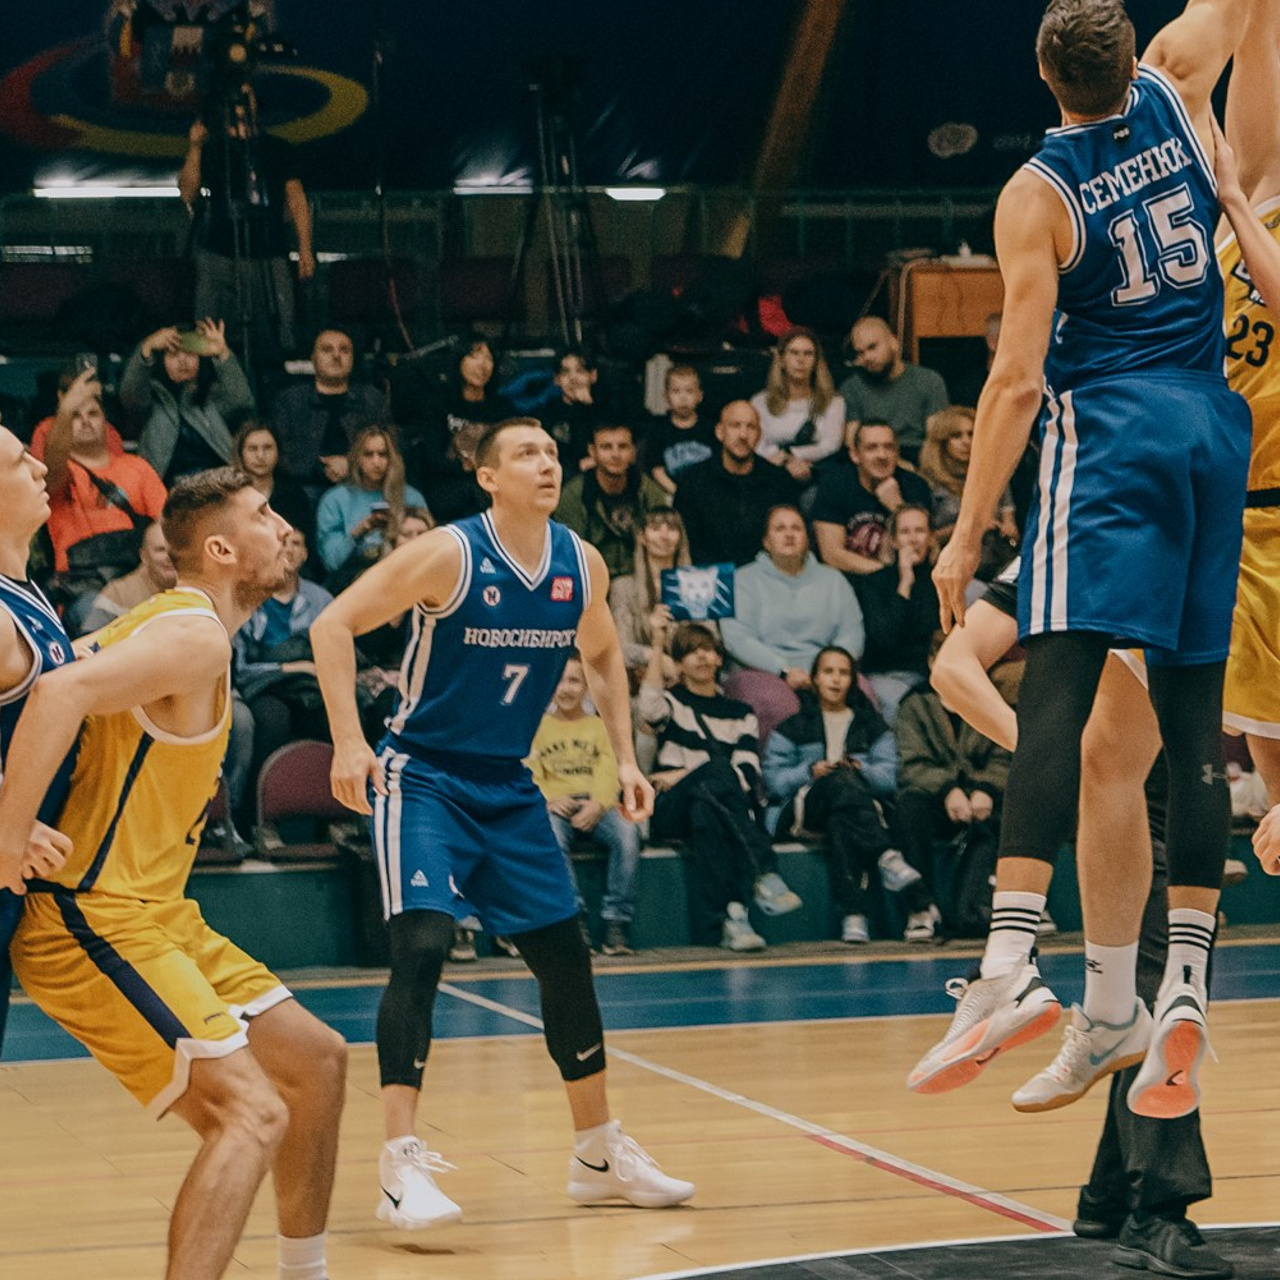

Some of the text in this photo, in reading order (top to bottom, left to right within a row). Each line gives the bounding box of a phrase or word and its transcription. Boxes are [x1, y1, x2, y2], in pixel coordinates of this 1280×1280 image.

[1079, 137, 1193, 215] СЕМЕНЮК
[1107, 182, 1210, 308] 15
[1226, 314, 1275, 368] 23
[501, 664, 530, 706] 7
